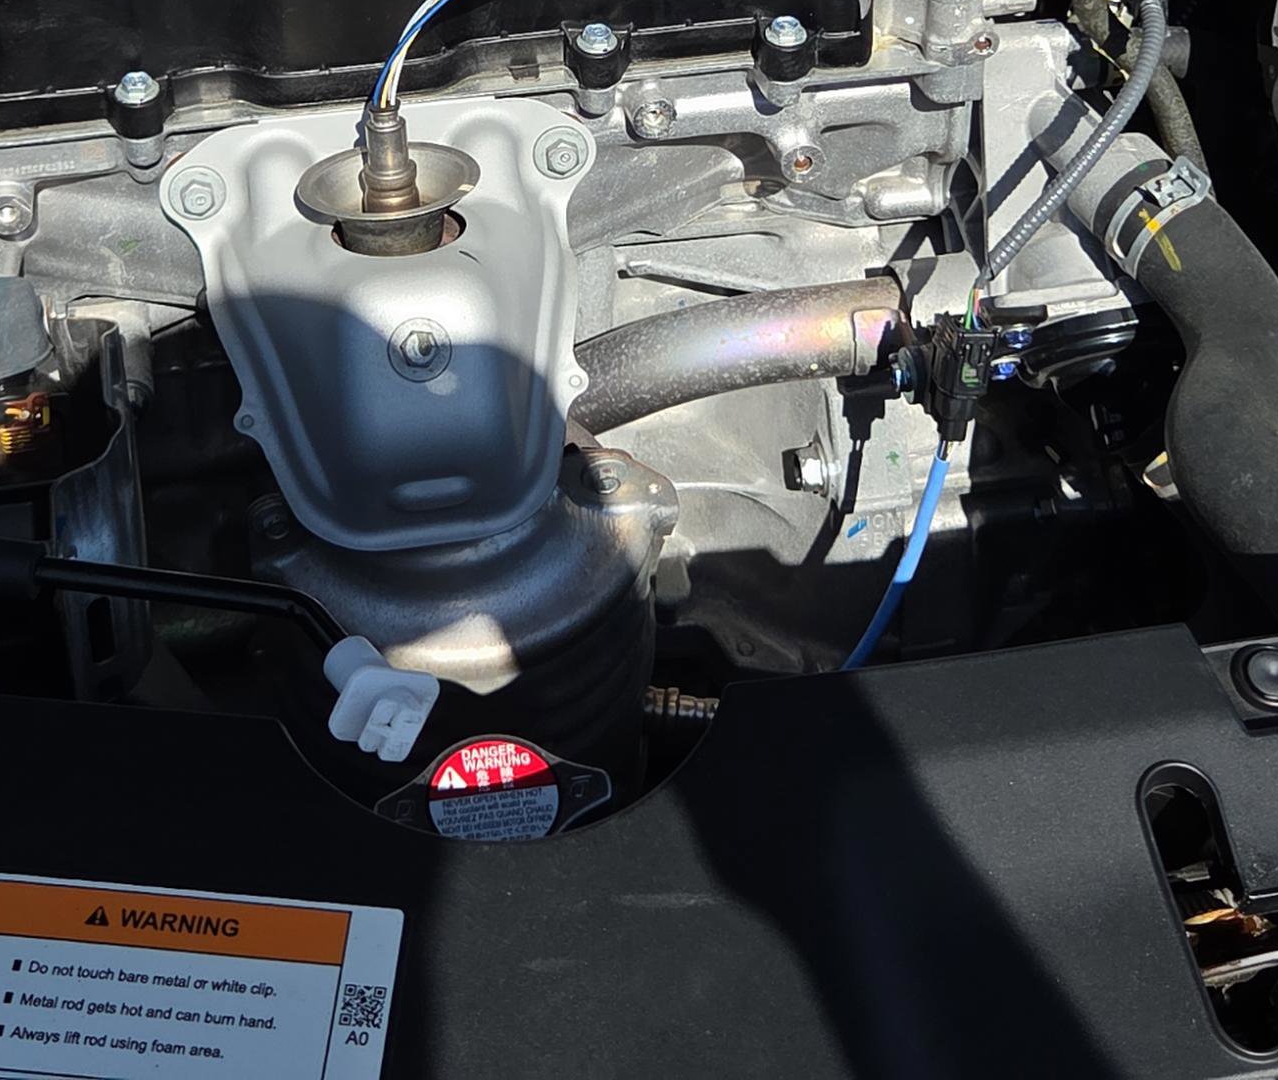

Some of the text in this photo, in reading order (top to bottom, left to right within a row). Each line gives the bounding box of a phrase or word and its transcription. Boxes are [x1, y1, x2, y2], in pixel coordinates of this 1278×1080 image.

[461, 743, 516, 761] DANGER
[463, 751, 532, 773] WARNUNG
[120, 908, 240, 938] WARNING
[28, 960, 277, 998] Do not touch bare metal or white clip.
[19, 993, 277, 1030] Metal rod gets hot and can burn hand.
[9, 1026, 225, 1059] Always lift rod using foam area.
[345, 1029, 369, 1048] A0
